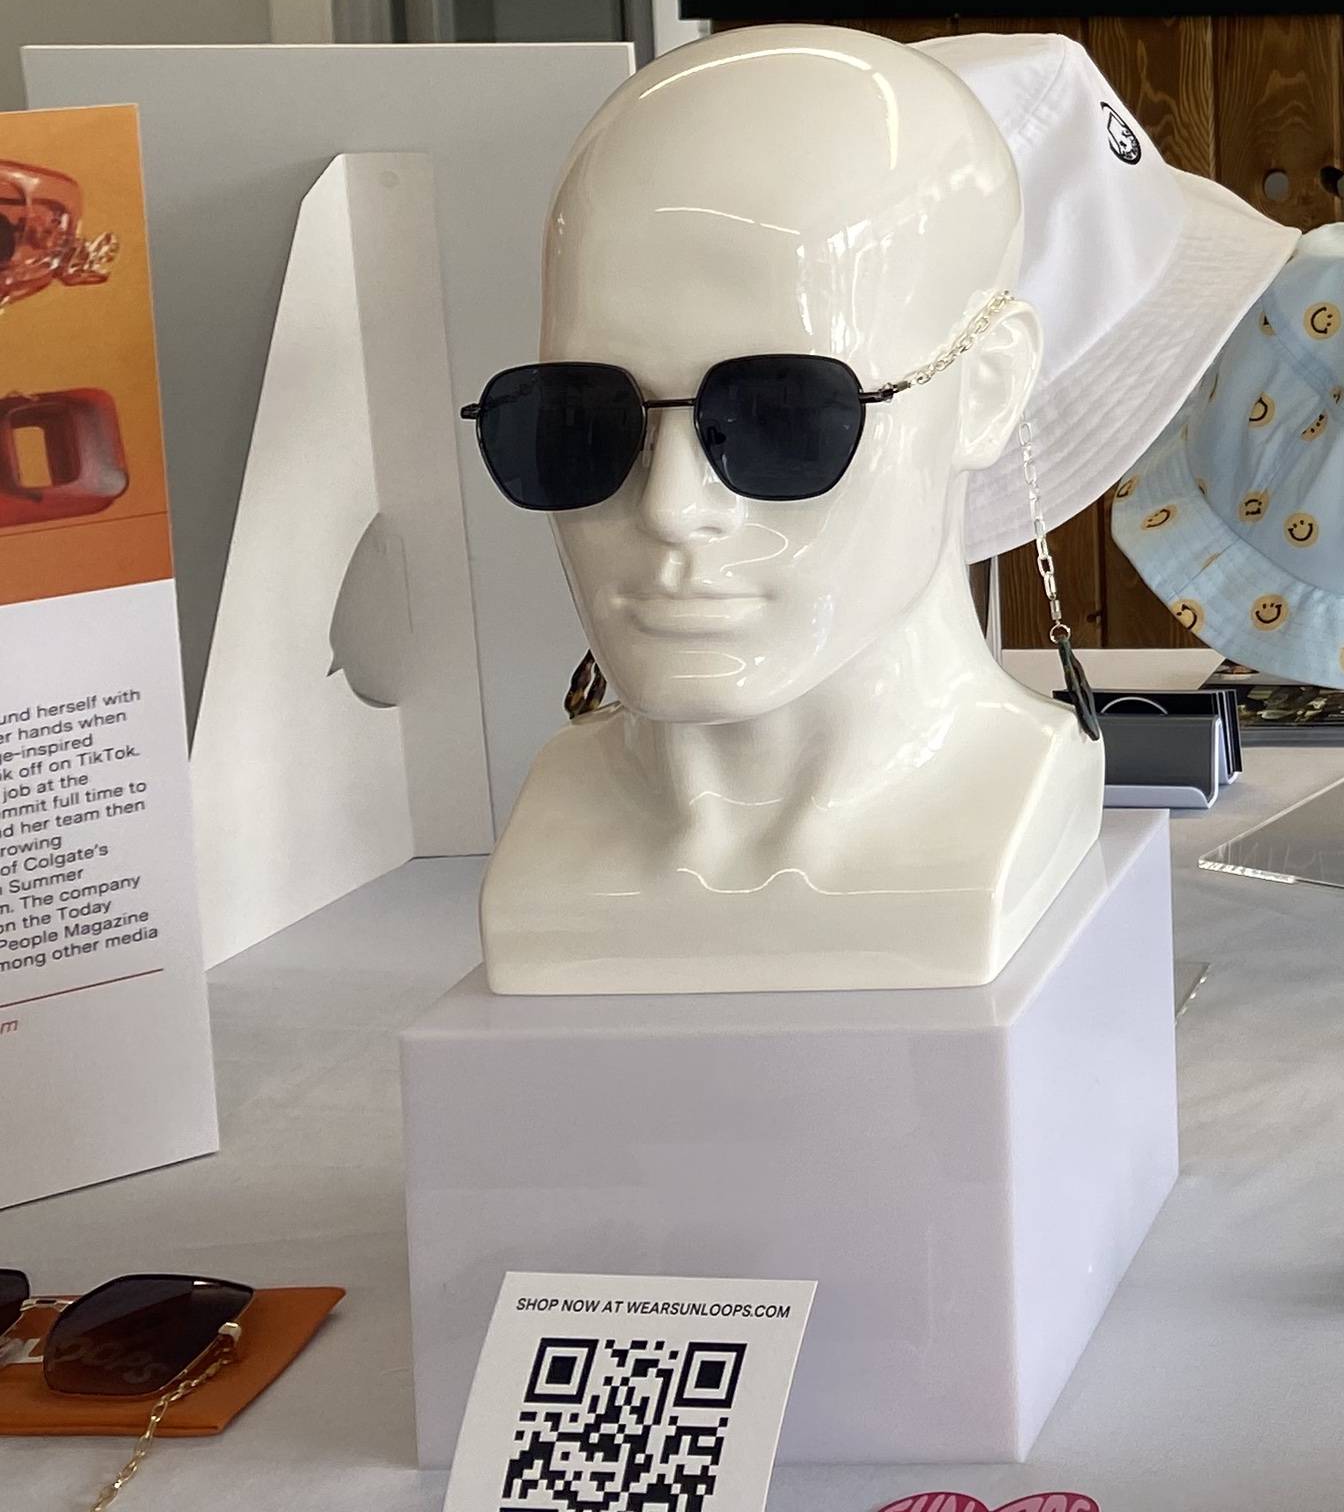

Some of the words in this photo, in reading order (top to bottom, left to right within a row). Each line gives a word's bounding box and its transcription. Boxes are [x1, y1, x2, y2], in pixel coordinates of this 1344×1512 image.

[36, 695, 97, 718] herself
[102, 689, 141, 706] with
[18, 720, 74, 741] hands
[78, 711, 127, 729] when
[19, 761, 43, 778] off
[49, 759, 72, 772] on
[77, 745, 141, 767] TikTok.
[3, 784, 31, 804] job
[37, 780, 55, 794] at
[60, 774, 89, 789] the
[53, 792, 80, 809] full
[85, 786, 123, 803] time
[129, 781, 147, 794] to
[20, 819, 50, 834] her
[55, 810, 100, 827] team
[106, 800, 146, 817] then
[0, 861, 18, 876] of
[23, 844, 109, 871] Colgate's
[9, 869, 84, 894] Summer
[19, 894, 54, 909] The
[59, 876, 141, 903] company
[22, 913, 51, 929] the
[56, 901, 112, 921] Today
[64, 910, 149, 939] Magazine
[52, 940, 99, 961] other
[105, 928, 158, 949] media
[516, 1297, 559, 1312] SHOP
[561, 1299, 600, 1314] NOW
[601, 1300, 624, 1313] AT
[626, 1301, 791, 1320] WEARSUNLOOPS.COM
